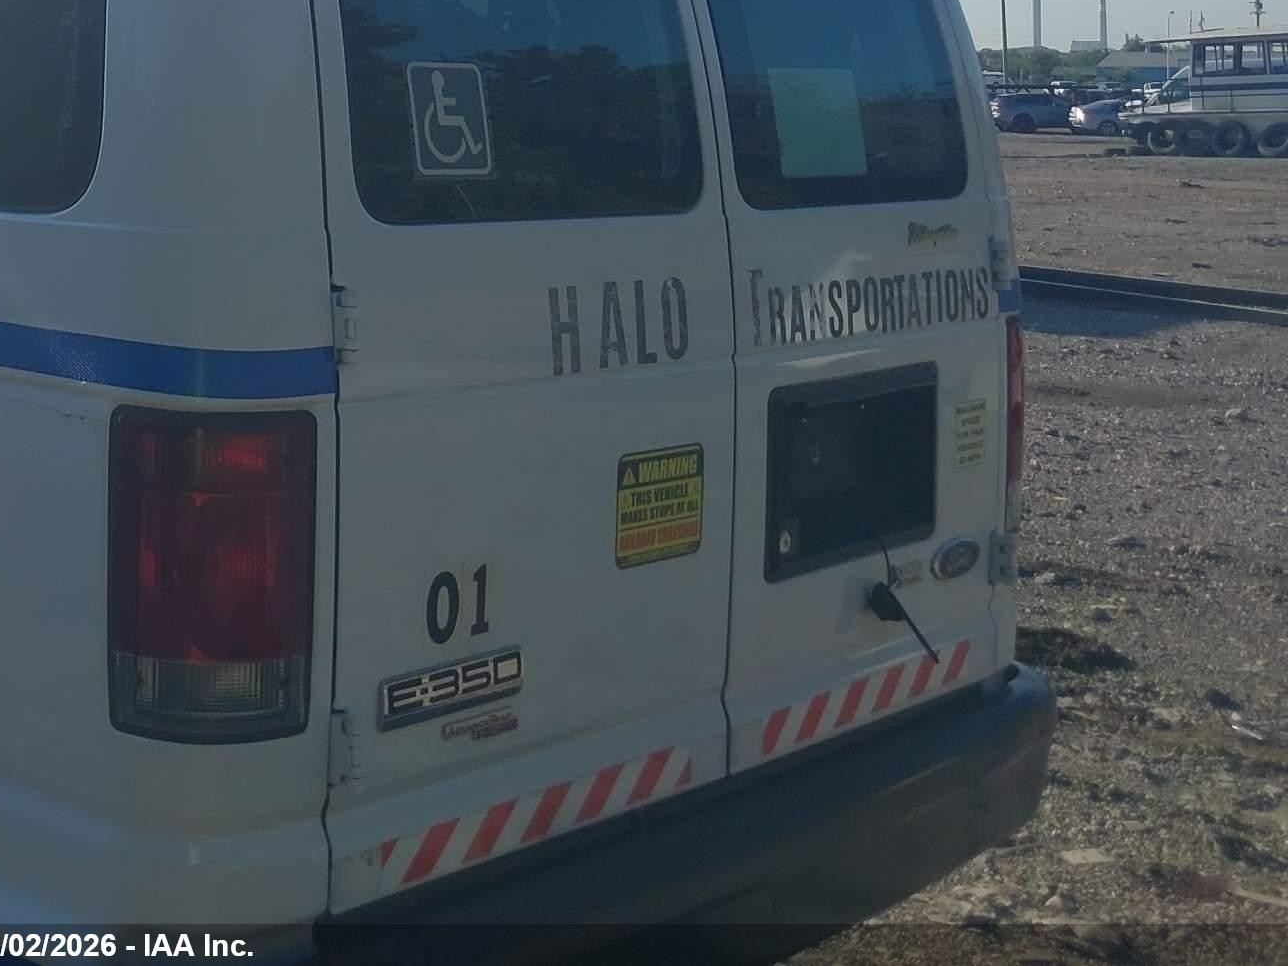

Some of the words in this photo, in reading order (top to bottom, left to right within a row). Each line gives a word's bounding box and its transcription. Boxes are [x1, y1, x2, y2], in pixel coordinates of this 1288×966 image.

[548, 276, 689, 376] HALO
[638, 453, 698, 483] WARNING
[620, 507, 648, 523] MAKES
[649, 502, 675, 519] STOPS
[631, 489, 652, 507] THIS
[654, 481, 689, 501] VEHICLE
[426, 563, 490, 644] 01
[388, 651, 522, 716] E-350
